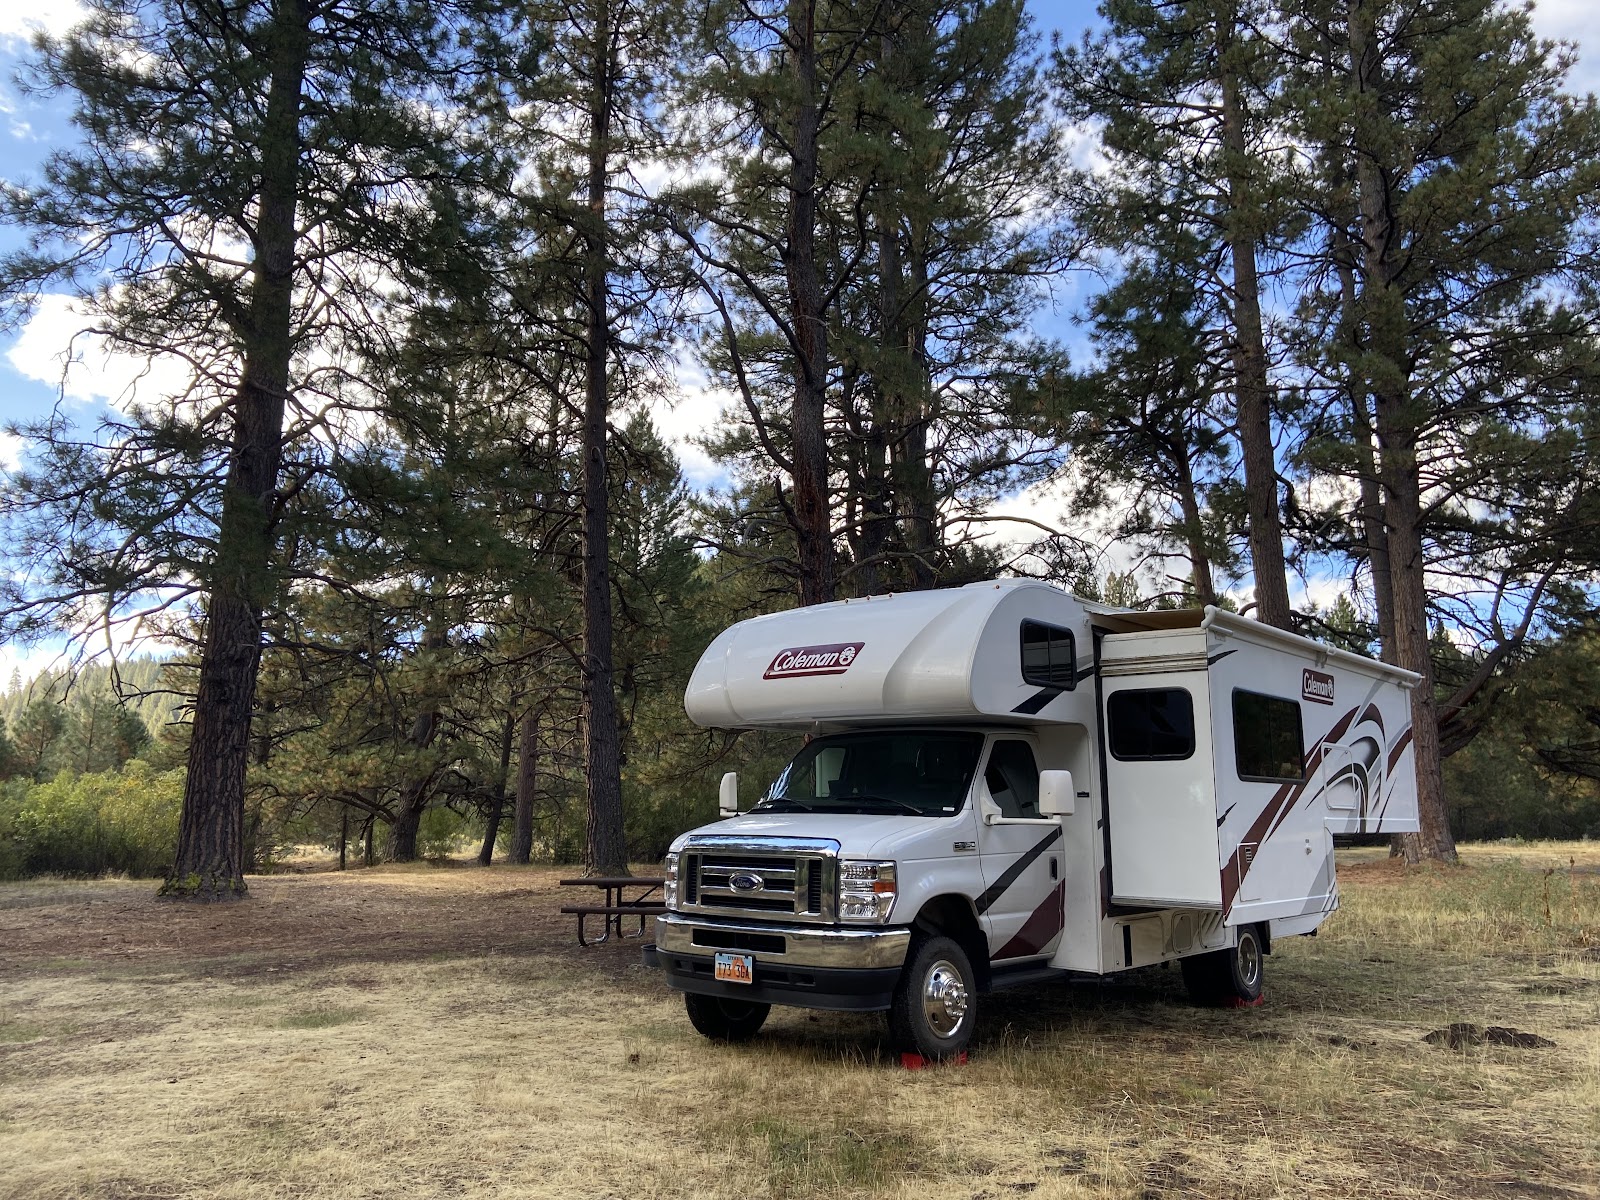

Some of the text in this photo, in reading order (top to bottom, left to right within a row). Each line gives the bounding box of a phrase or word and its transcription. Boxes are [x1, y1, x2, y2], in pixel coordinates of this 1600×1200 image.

[773, 649, 839, 671] Coleman
[1304, 671, 1328, 697] Coleman
[735, 877, 751, 887] Ford
